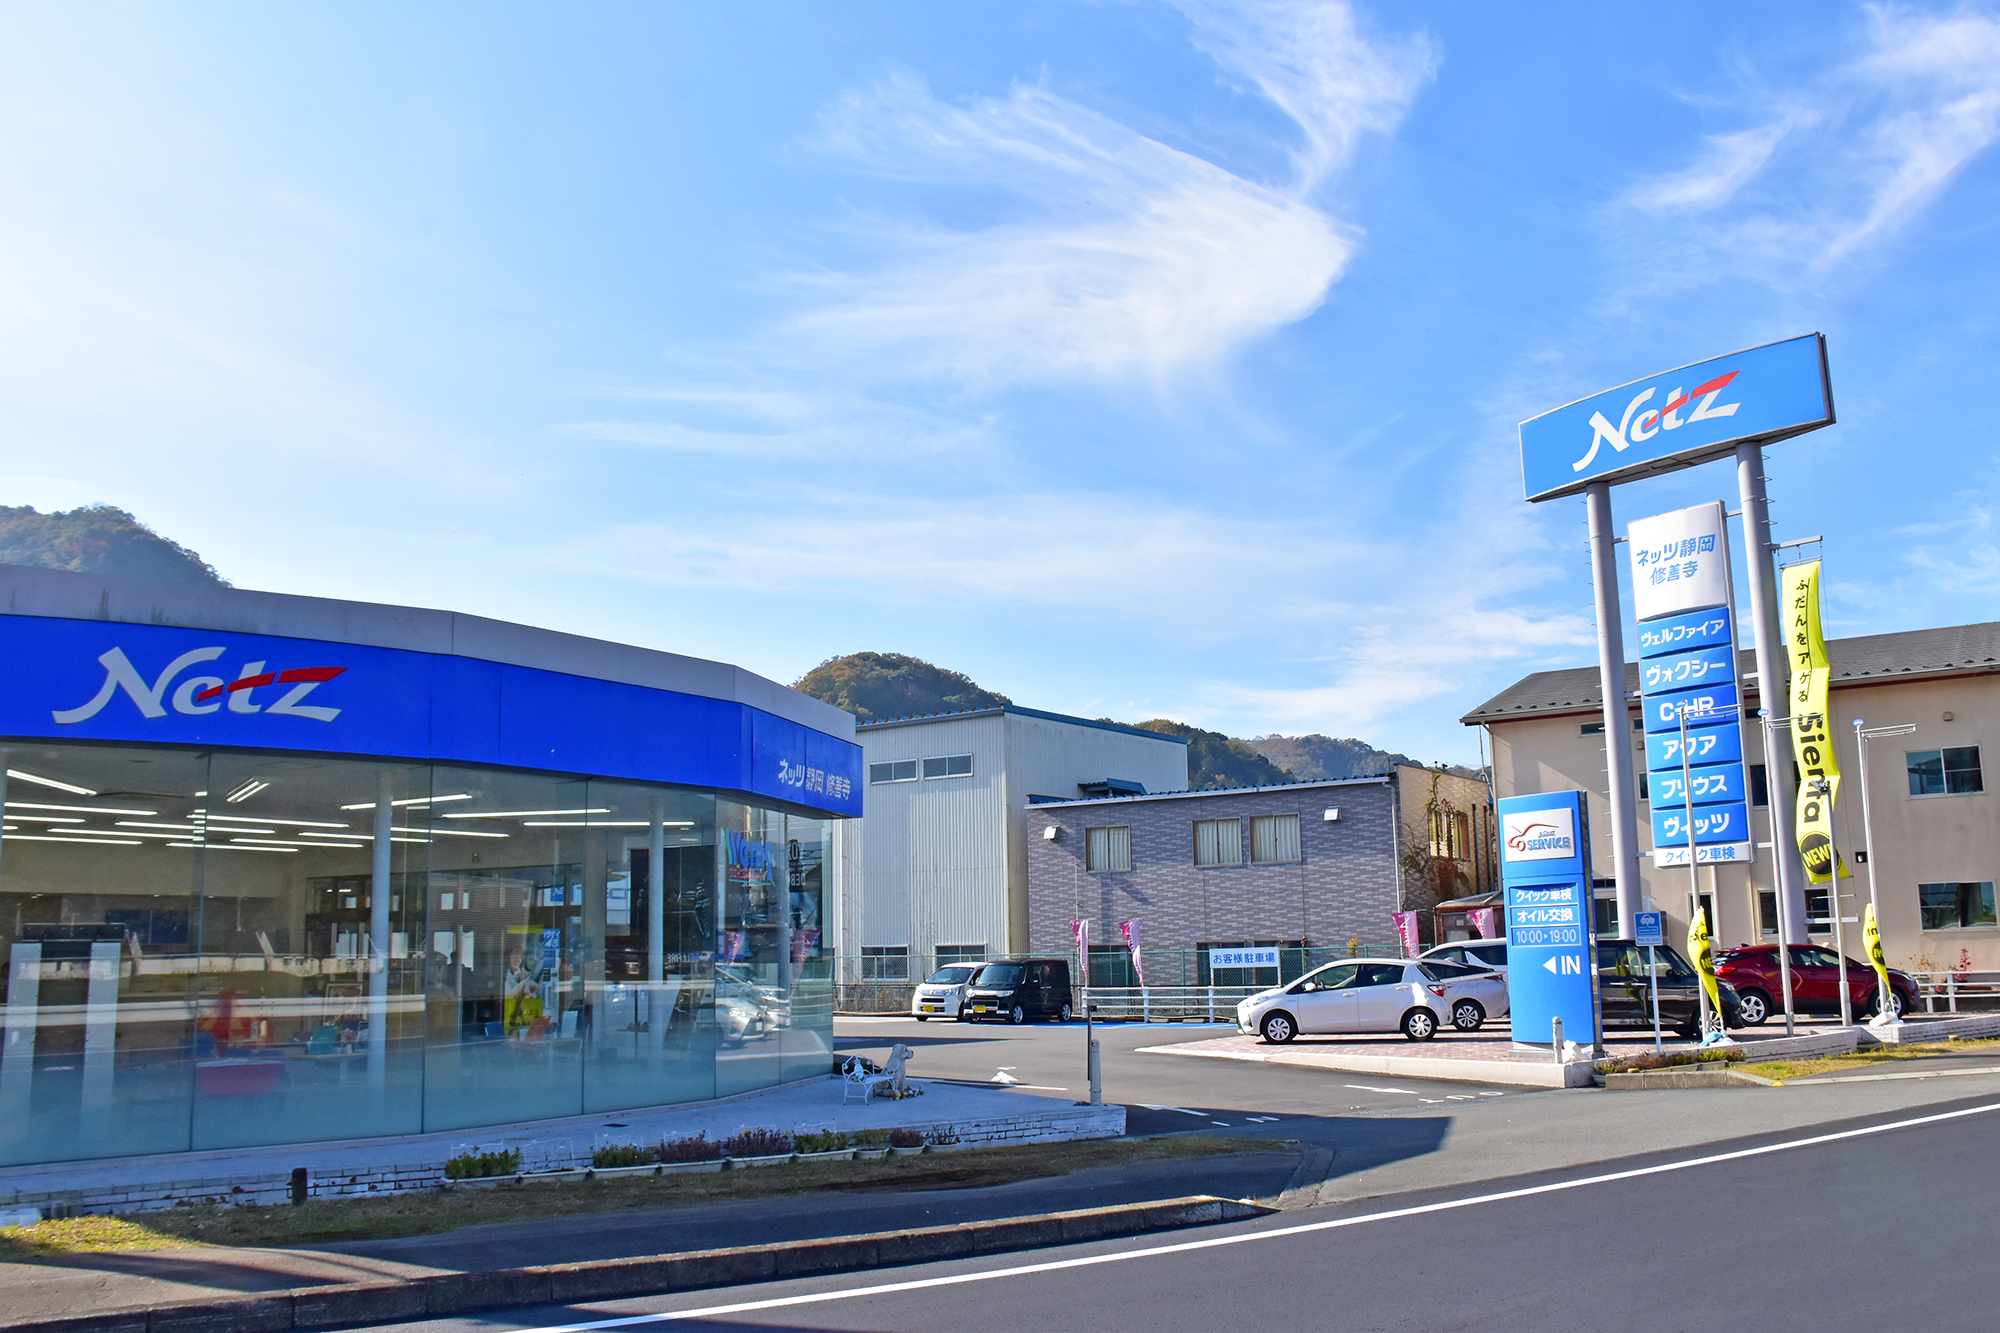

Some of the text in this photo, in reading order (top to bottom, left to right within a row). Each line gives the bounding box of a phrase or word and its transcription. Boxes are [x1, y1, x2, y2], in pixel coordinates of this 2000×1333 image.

[1572, 370, 1741, 472] Netz
[1636, 533, 1716, 567] ネッツ静岡
[1650, 560, 1698, 586] 修善寺
[1641, 619, 1725, 648] ヴェルファイア
[52, 646, 349, 725] Netz
[1646, 659, 1726, 687] ヴォクシー
[1659, 696, 1715, 722] C-HR
[1662, 734, 1717, 760] アクア
[778, 758, 851, 801] ネッツ静岡 修善寺
[1527, 836, 1571, 851] SERVICE
[1665, 846, 1736, 863] クイク車検
[1516, 887, 1572, 903] クイック車検
[1517, 908, 1573, 923] オイル交換
[1213, 952, 1276, 964] お客様駐車場
[1561, 955, 1581, 975] IN
